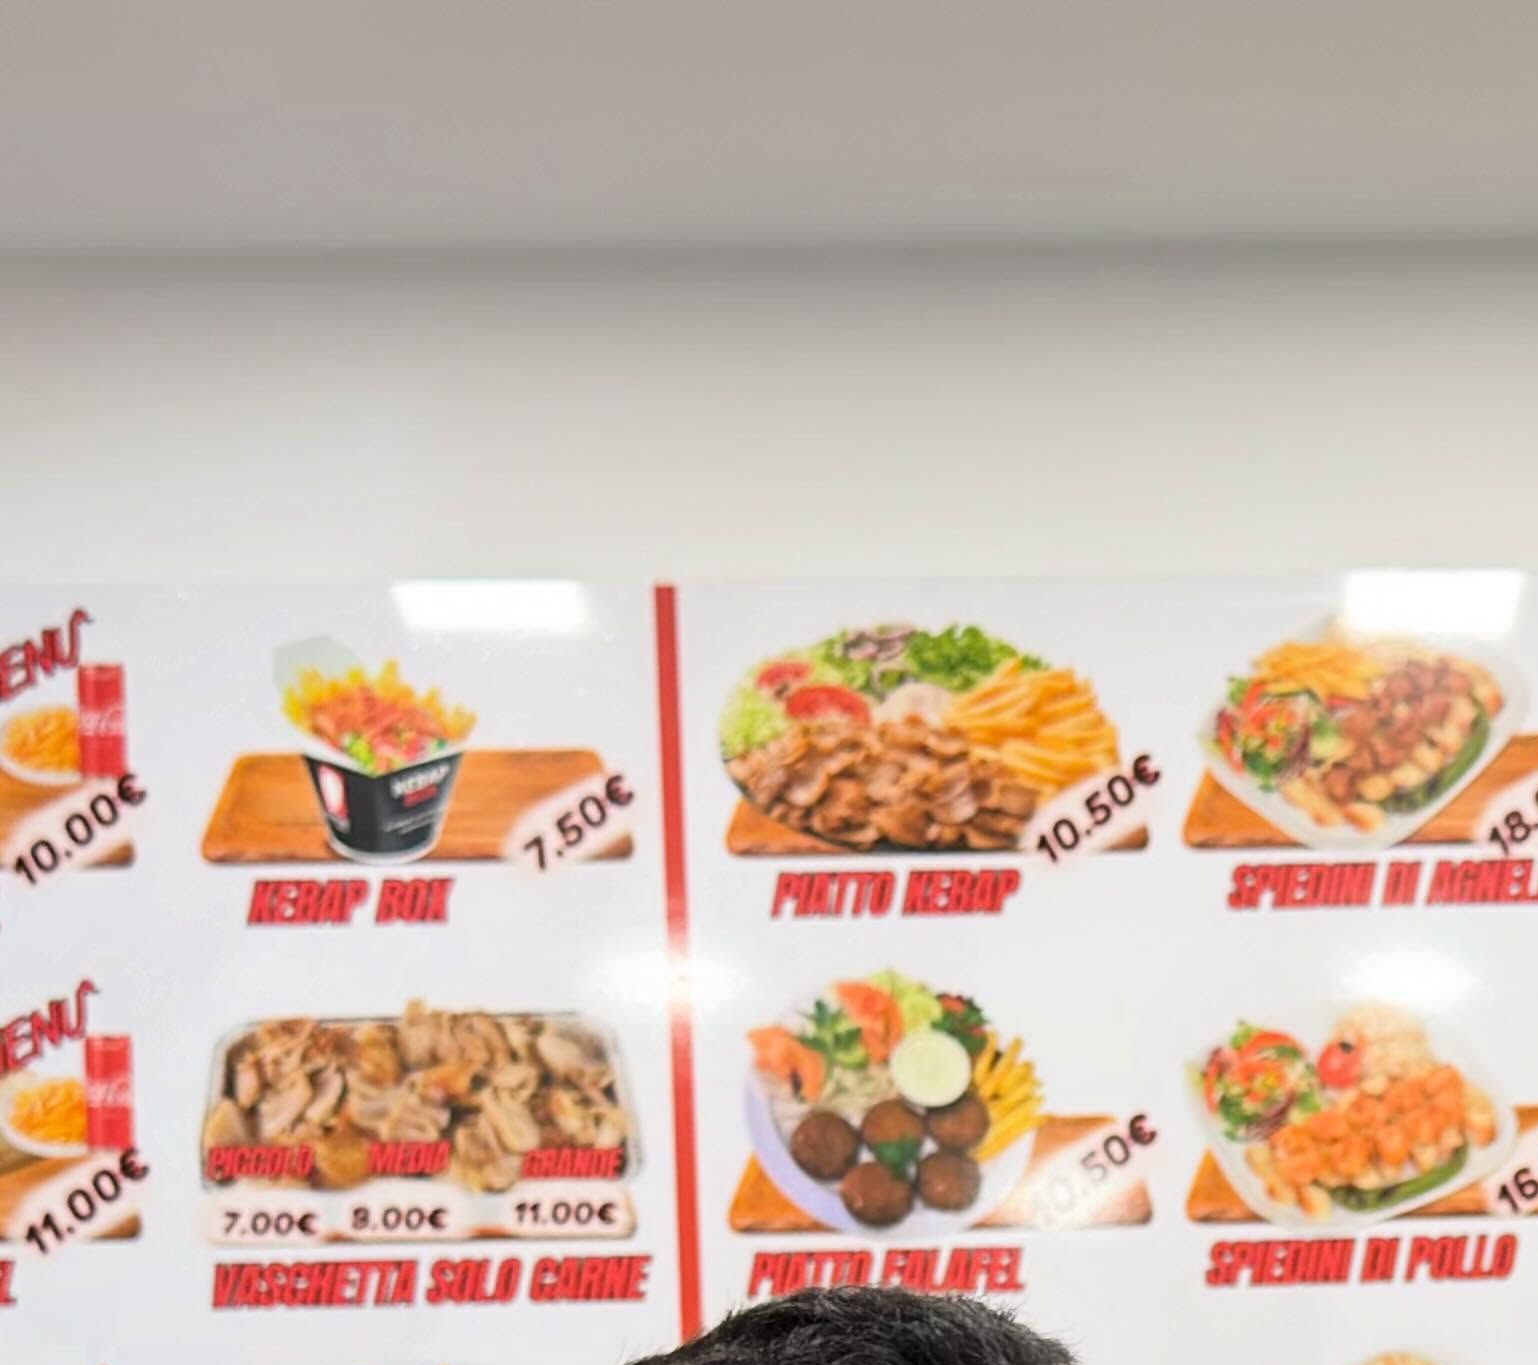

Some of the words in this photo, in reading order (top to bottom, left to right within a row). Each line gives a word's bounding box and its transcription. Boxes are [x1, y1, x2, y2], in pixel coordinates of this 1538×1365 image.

[0, 607, 93, 700] ENU
[12, 773, 147, 886] 10.00€
[523, 774, 636, 873] 7.50€
[1036, 752, 1163, 865] 10.50€
[247, 878, 368, 927] KEBAP
[375, 876, 454, 925] BOX
[770, 870, 896, 920] PIATTO
[901, 868, 1022, 916] KEBAP
[1227, 862, 1377, 912] SPIEDINI
[1382, 861, 1422, 908] DI
[0, 979, 99, 1075] ENU
[519, 1139, 627, 1179] GRANDE
[24, 1144, 150, 1255] 11.00€
[223, 1210, 318, 1237] 7.00€
[513, 1200, 619, 1227] 11.00€
[212, 1257, 415, 1310] VASCHETTA
[426, 1256, 519, 1305] SOLO
[528, 1253, 654, 1304] CARNE
[747, 1249, 873, 1299] PIATTO
[881, 1245, 1026, 1294] FALAFEL
[1205, 1238, 1355, 1288] SPIEDINI
[1360, 1237, 1400, 1284] DI
[1405, 1232, 1519, 1283] POLLO
